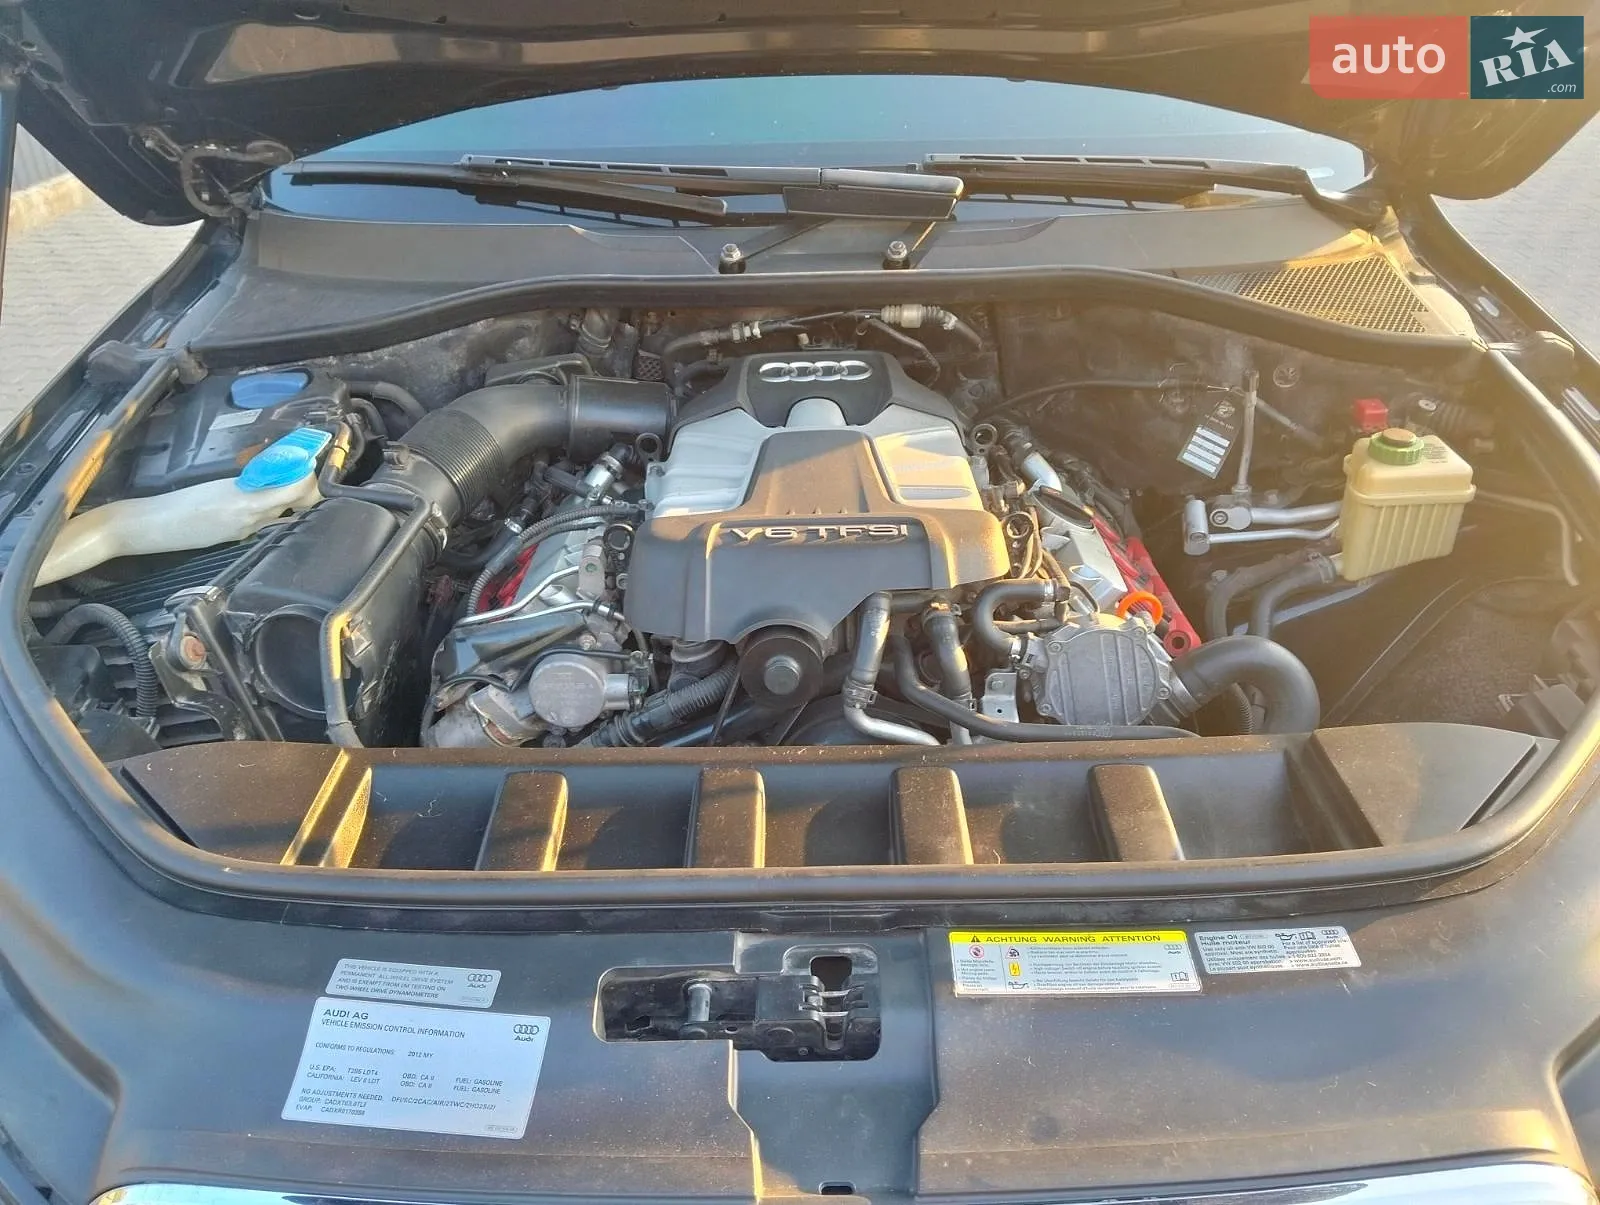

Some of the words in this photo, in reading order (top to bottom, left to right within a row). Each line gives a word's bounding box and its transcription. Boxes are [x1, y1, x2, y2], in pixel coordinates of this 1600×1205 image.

[730, 527, 798, 540] V6
[808, 524, 909, 539] TFSI
[986, 935, 1038, 944] ACHTUNG
[1042, 935, 1096, 943] WARNING
[1102, 934, 1160, 942] ATTENTION
[389, 990, 439, 998] DYNAMOMETERS
[323, 1008, 350, 1018] AUDI
[352, 1011, 369, 1020] AG
[322, 1018, 349, 1028] VEHICLE
[350, 1021, 383, 1031] EMISSION
[384, 1024, 416, 1034] CONTROL
[417, 1028, 466, 1038] INFORMATION
[315, 1042, 346, 1051] CONFORMS
[312, 1089, 357, 1099] ADJUSTMENTS
